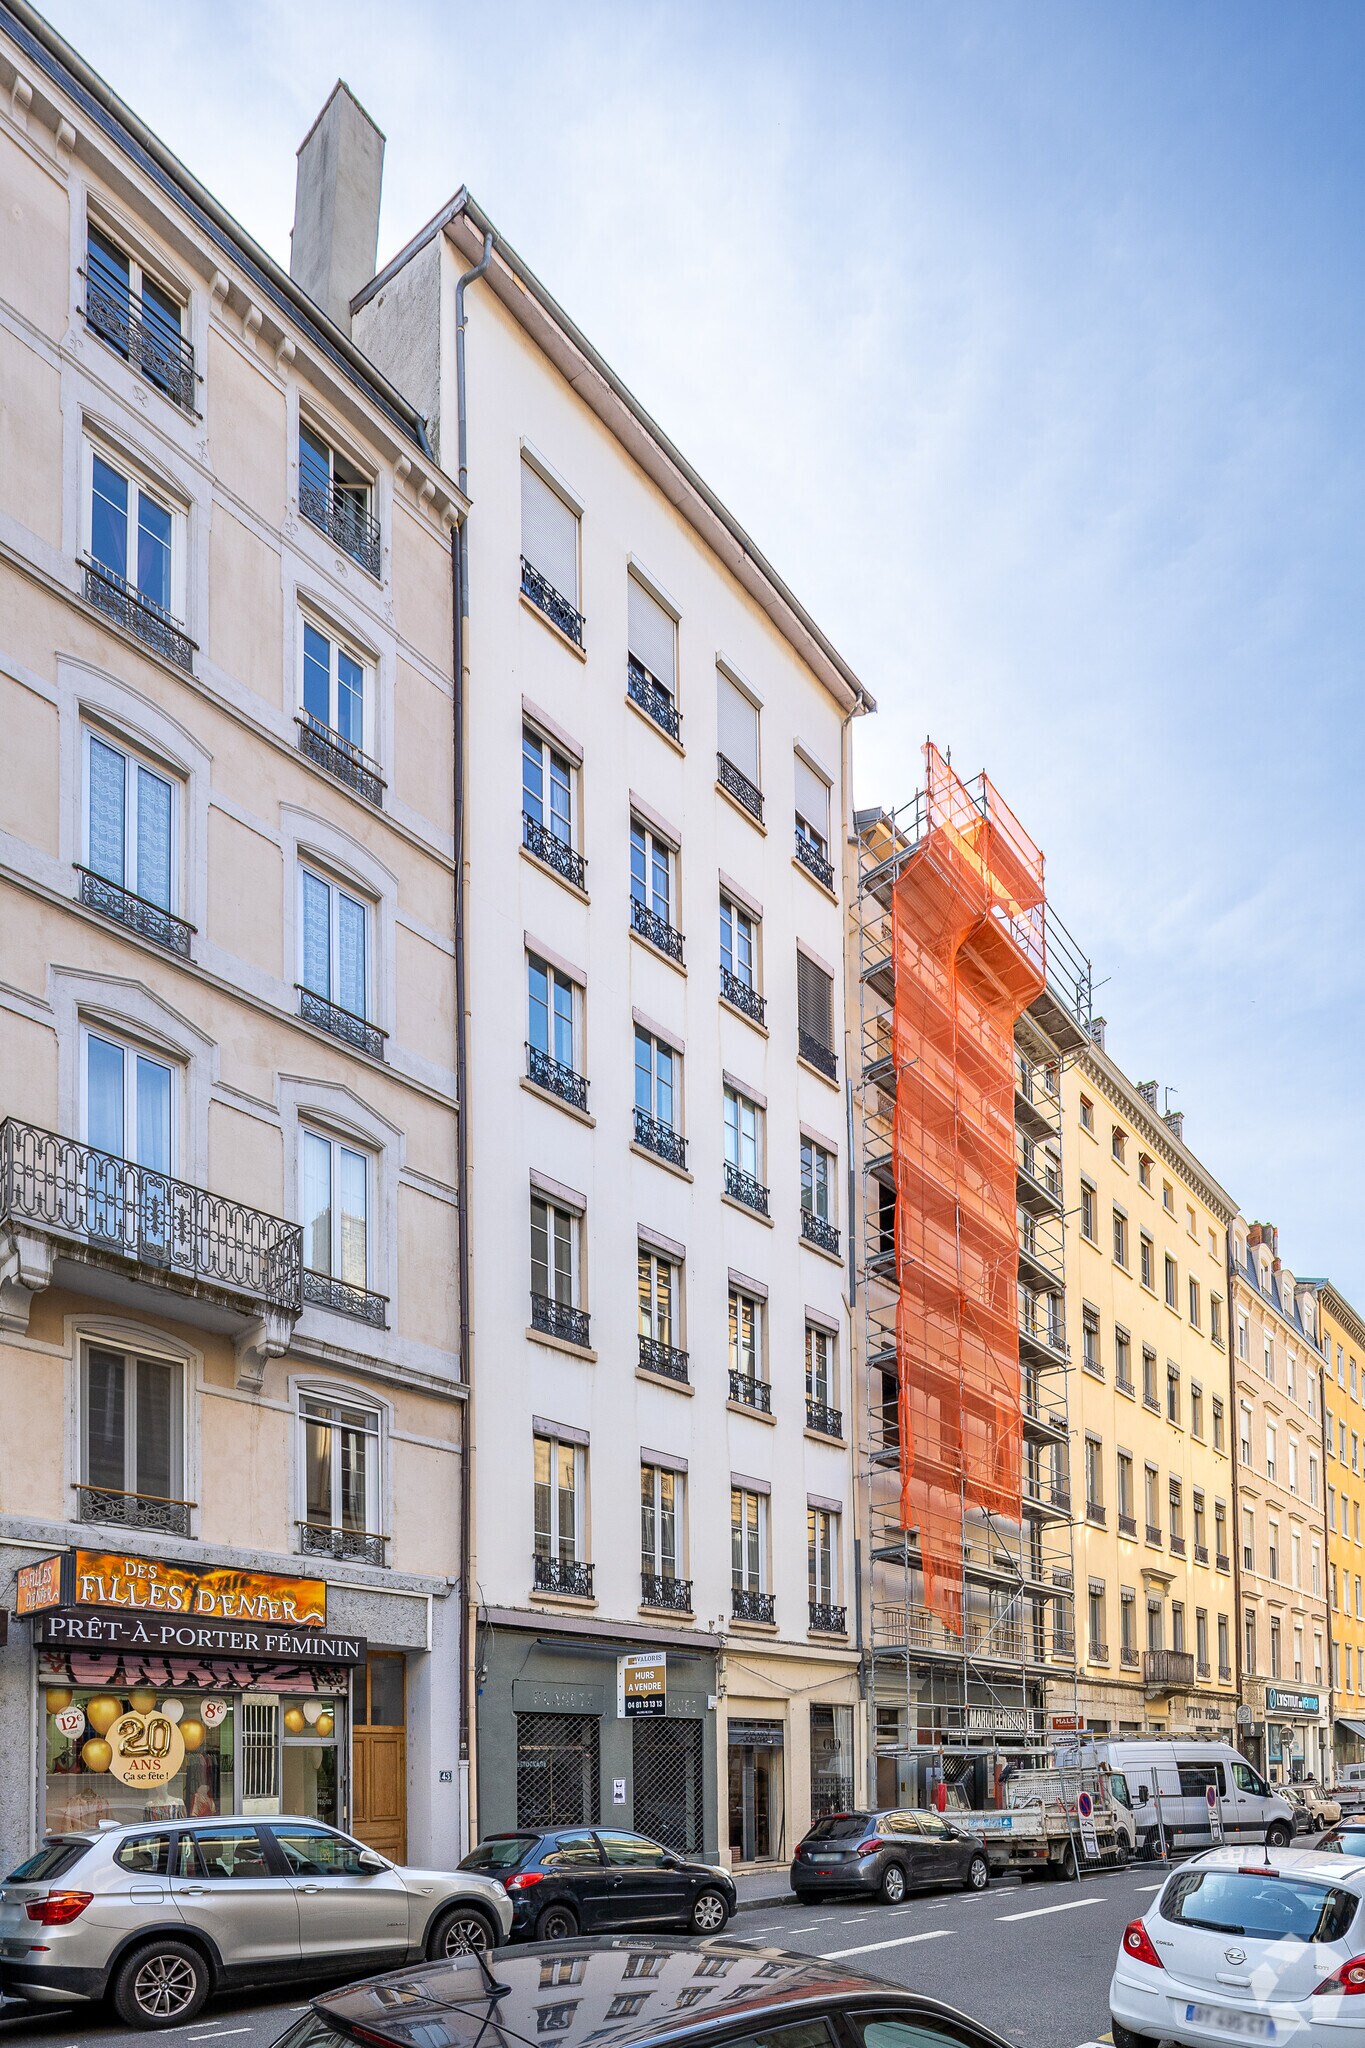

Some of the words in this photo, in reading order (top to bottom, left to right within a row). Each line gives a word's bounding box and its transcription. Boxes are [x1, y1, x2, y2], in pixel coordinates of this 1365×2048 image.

[124, 1561, 158, 1579] DES
[29, 1566, 52, 1588] FILLES
[80, 1575, 184, 1610] FILLES
[197, 1589, 324, 1623] D'ENFER
[48, 1617, 259, 1650] PRÊT-À-PORTER
[265, 1633, 360, 1658] FÉMININ
[636, 1654, 662, 1662] VALORIS
[635, 1671, 655, 1680] MURS
[628, 1683, 634, 1692] A
[634, 1682, 662, 1691] VENDRE
[205, 1703, 223, 1718] 8€
[627, 1701, 635, 1709] 04
[60, 1714, 83, 1731] 12€
[117, 1716, 172, 1758] 20
[128, 1759, 161, 1771] ANS
[122, 1772, 136, 1782] Ça
[148, 1771, 165, 1780] fête
[441, 1772, 451, 1780] 43
[1155, 1939, 1174, 1948] CORSA
